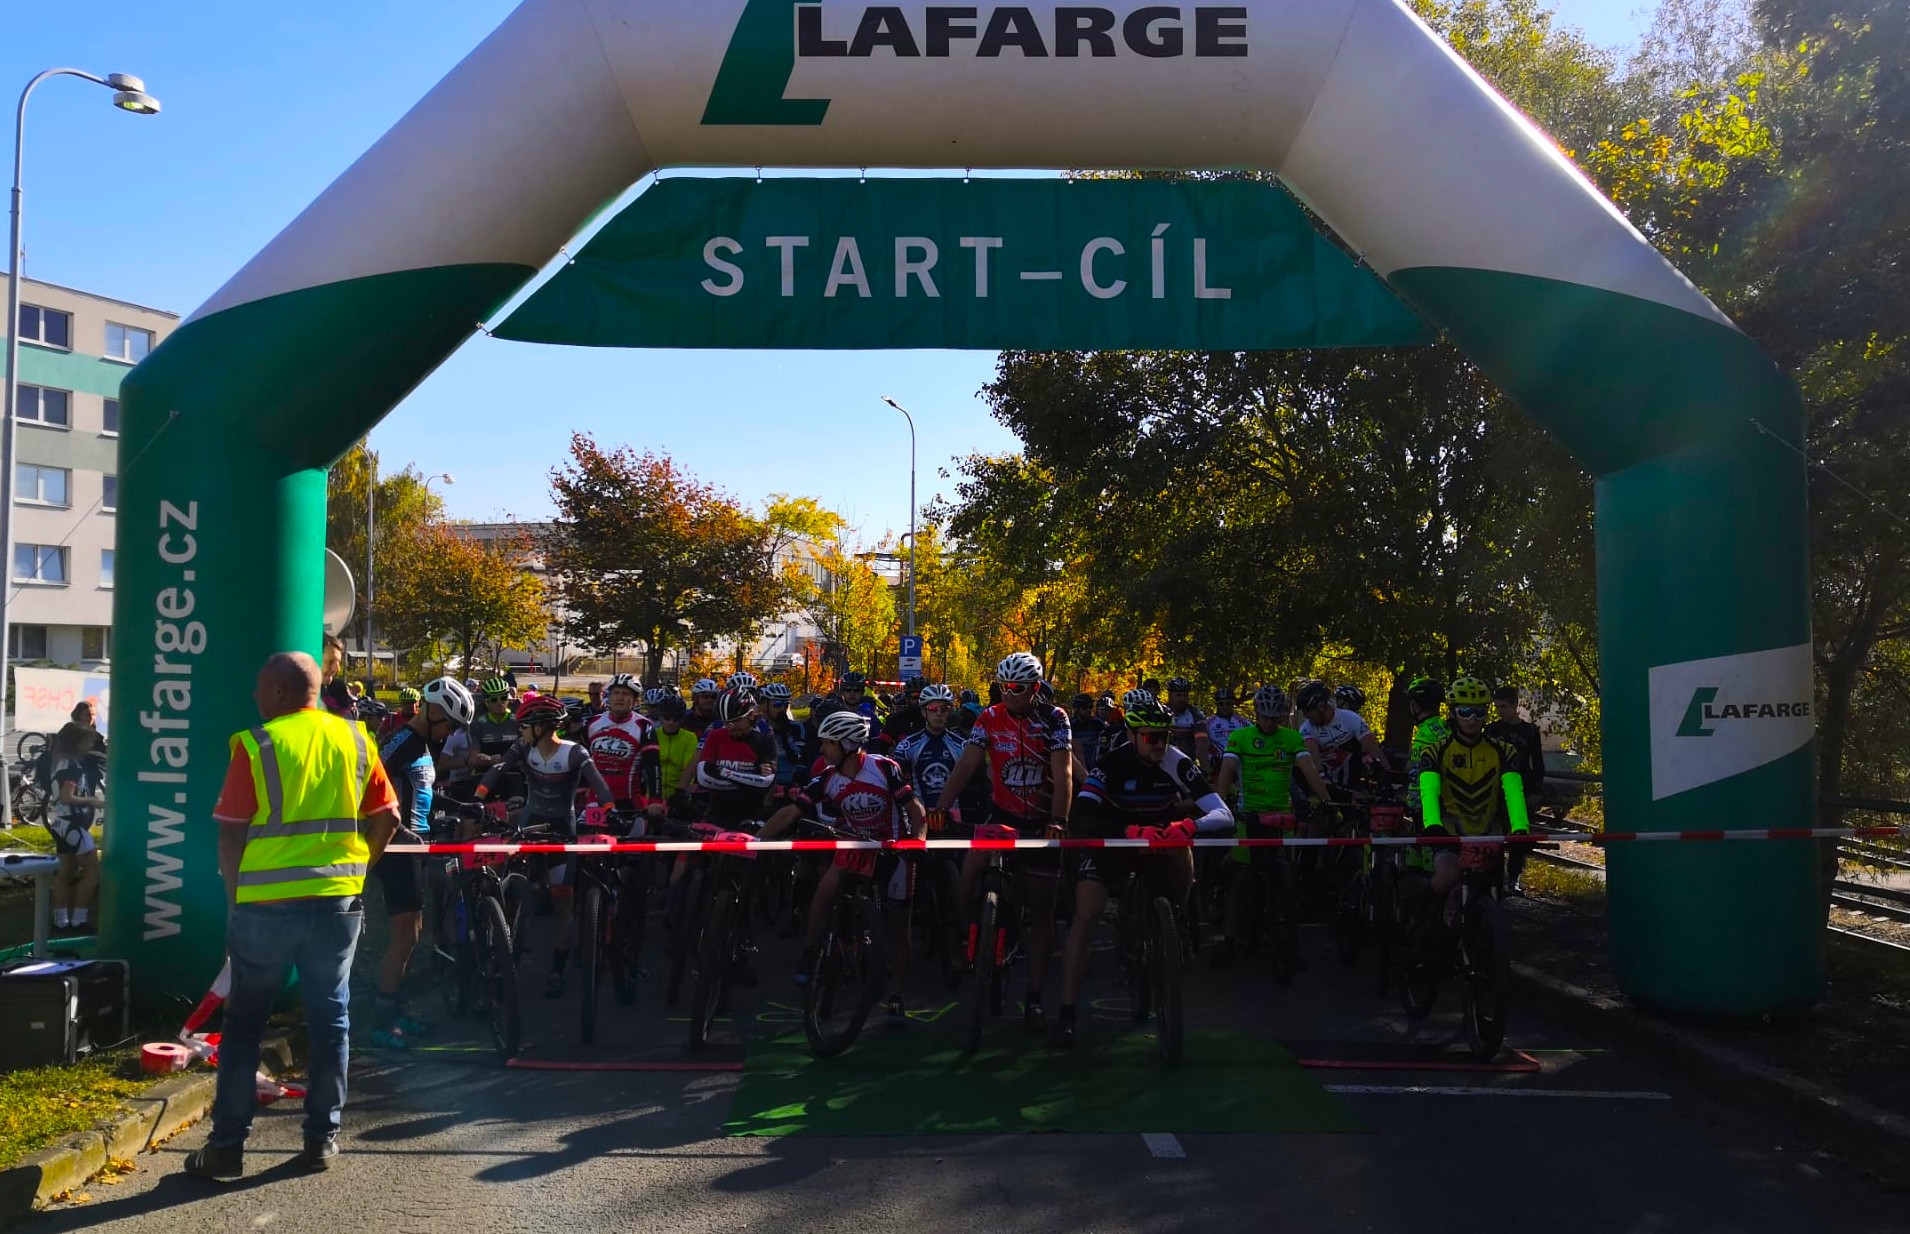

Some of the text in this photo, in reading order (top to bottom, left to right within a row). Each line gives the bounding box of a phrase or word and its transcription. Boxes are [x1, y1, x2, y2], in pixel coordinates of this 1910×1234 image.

[799, 6, 1249, 57] LAFARGE
[904, 638, 916, 655] P
[1704, 702, 1810, 719] LAFARGE
[138, 499, 207, 941] www.lafarge.cz
[592, 811, 601, 823] 9
